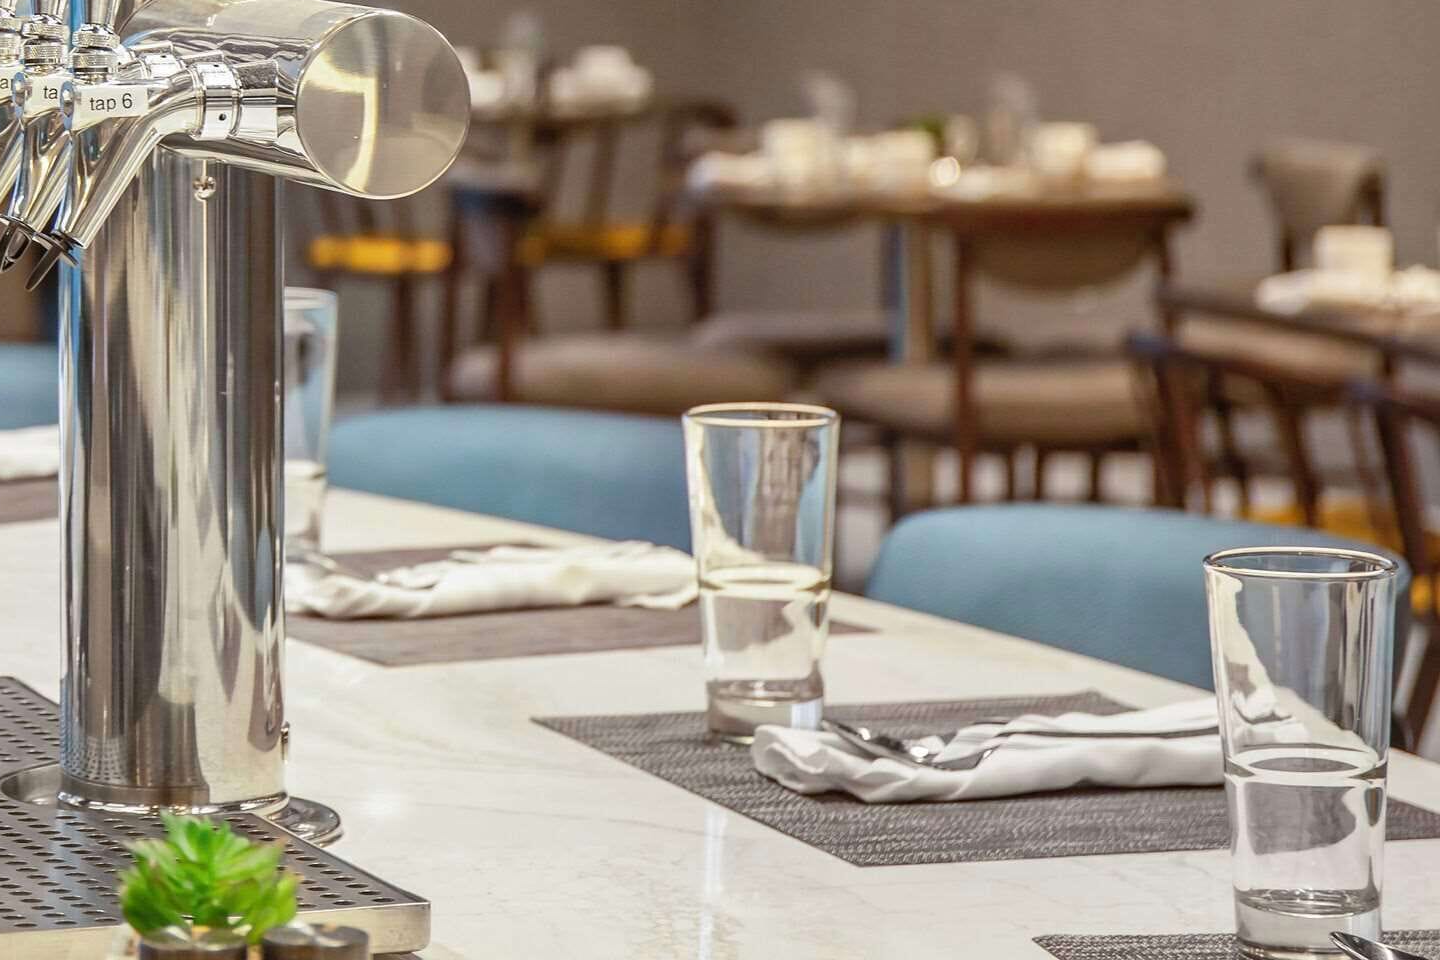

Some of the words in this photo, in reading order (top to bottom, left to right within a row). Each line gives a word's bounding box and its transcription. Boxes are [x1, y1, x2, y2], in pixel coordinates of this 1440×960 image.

[43, 85, 58, 100] ta
[89, 97, 117, 113] tap
[122, 92, 133, 109] 6
